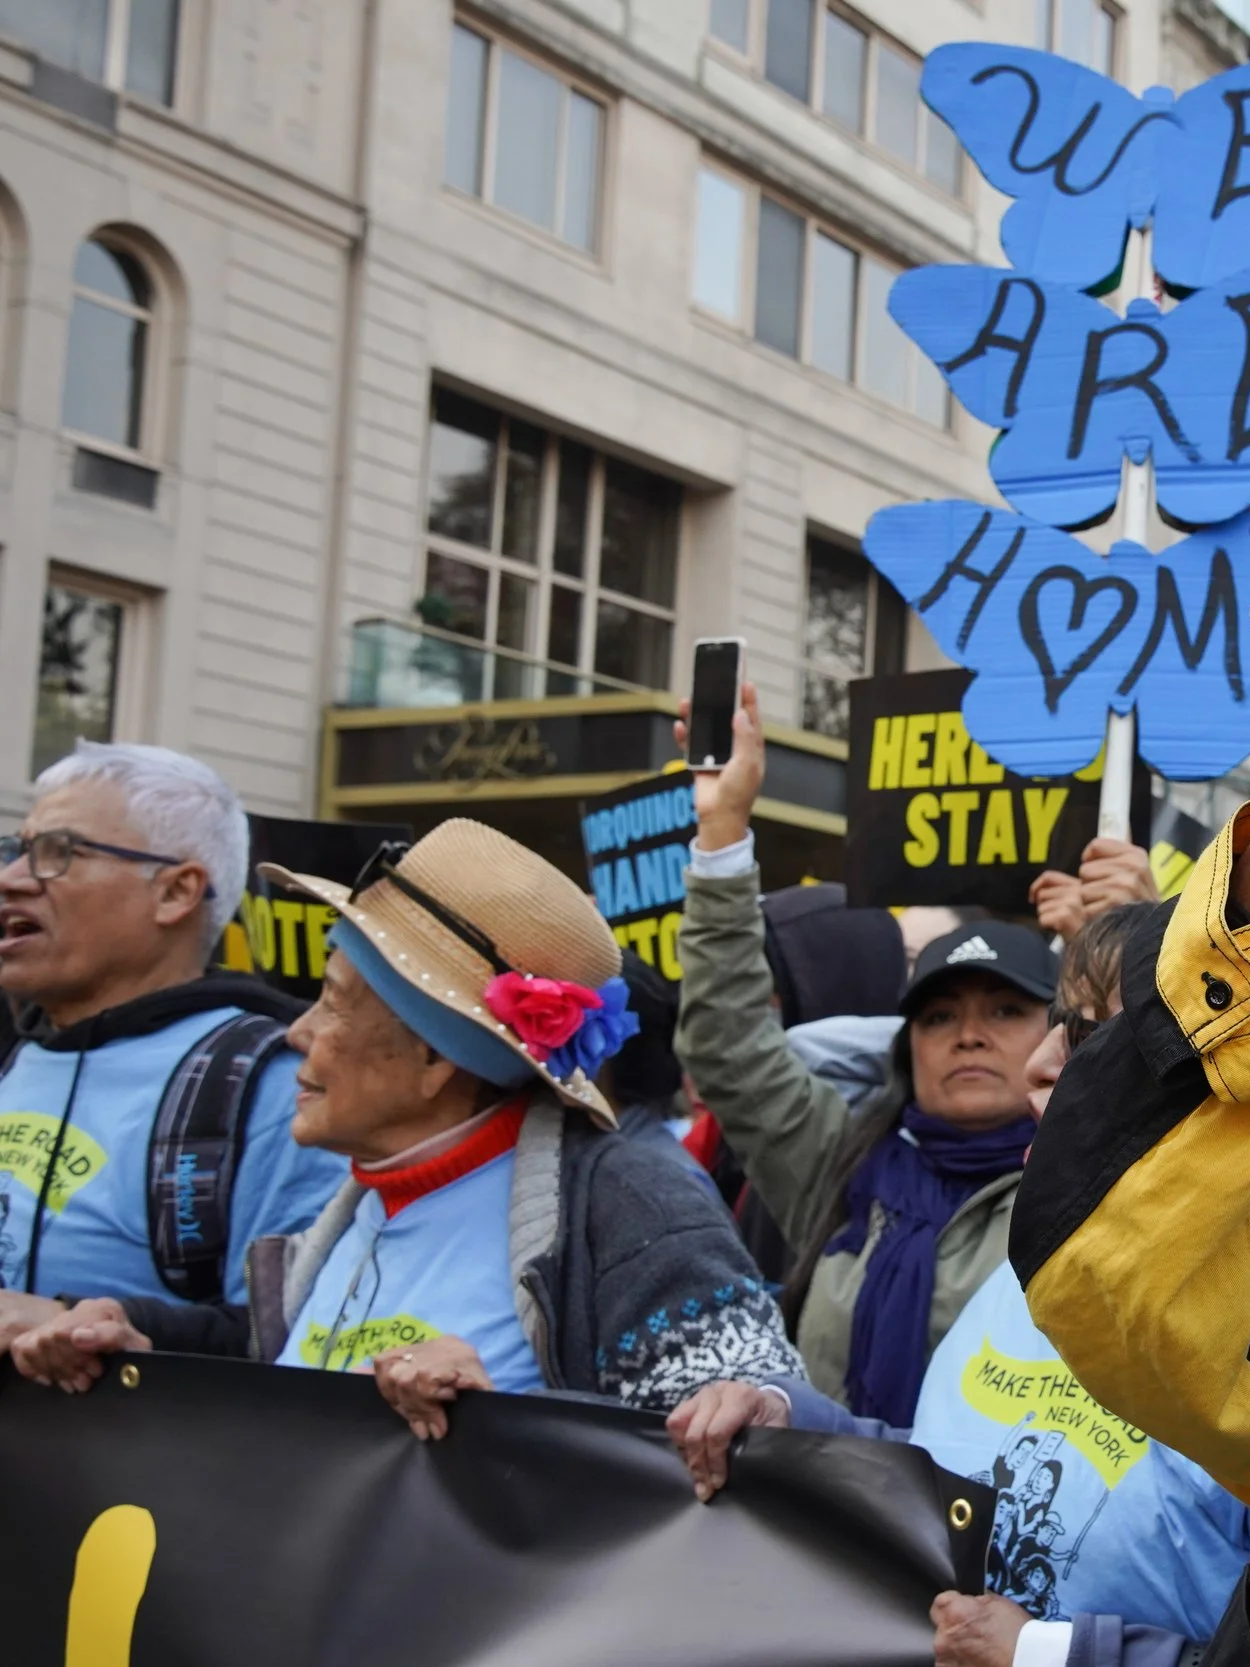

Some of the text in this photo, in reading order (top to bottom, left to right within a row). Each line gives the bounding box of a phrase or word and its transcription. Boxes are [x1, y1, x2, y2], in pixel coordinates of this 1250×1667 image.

[903, 788, 1070, 868] STAY
[975, 1360, 1079, 1398] MAKE THE
[1045, 1406, 1088, 1428] NEW
[1086, 1420, 1131, 1468] YORK
